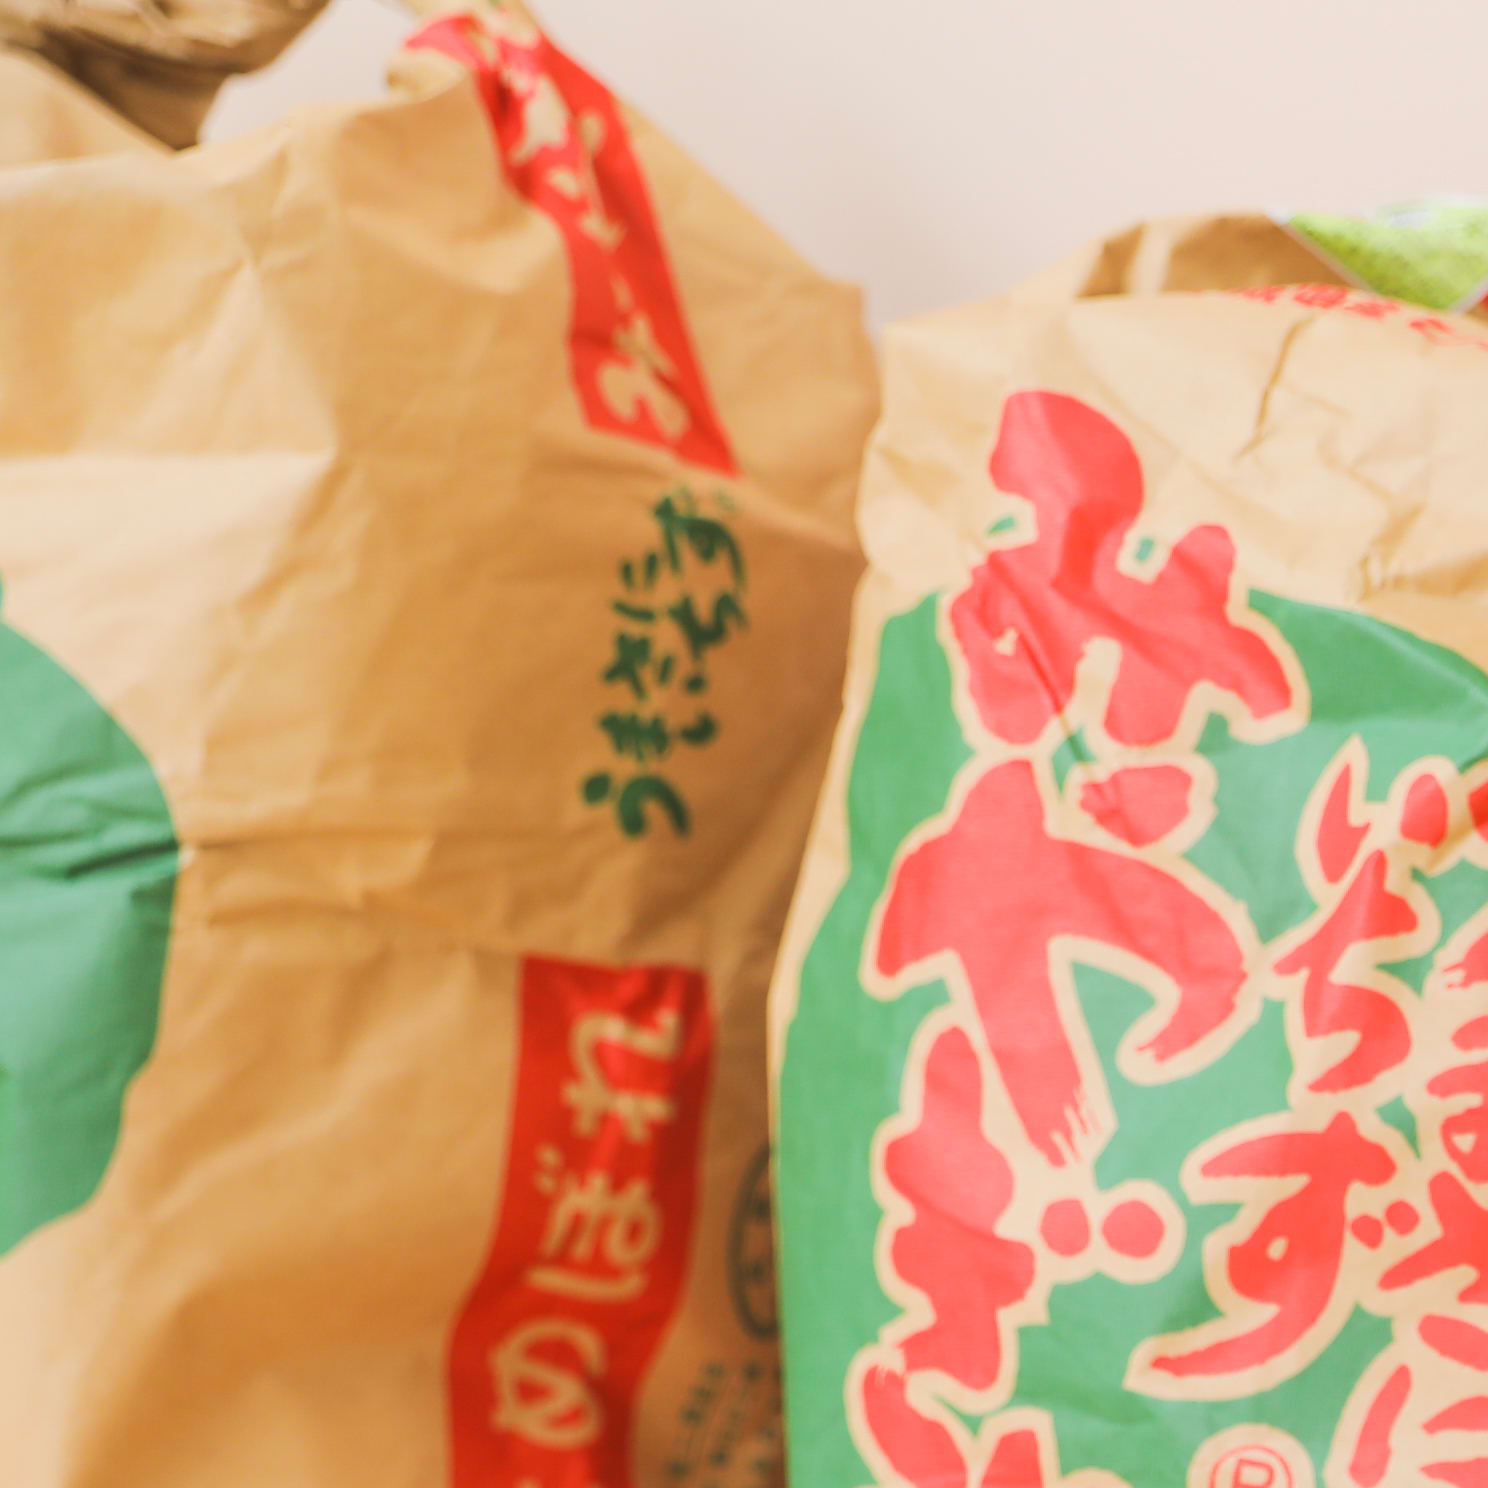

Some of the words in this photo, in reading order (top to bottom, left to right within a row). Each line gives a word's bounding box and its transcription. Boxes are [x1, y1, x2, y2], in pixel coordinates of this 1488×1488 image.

[582, 551, 690, 838] うまさに
[1148, 761, 1449, 1376] いちず
